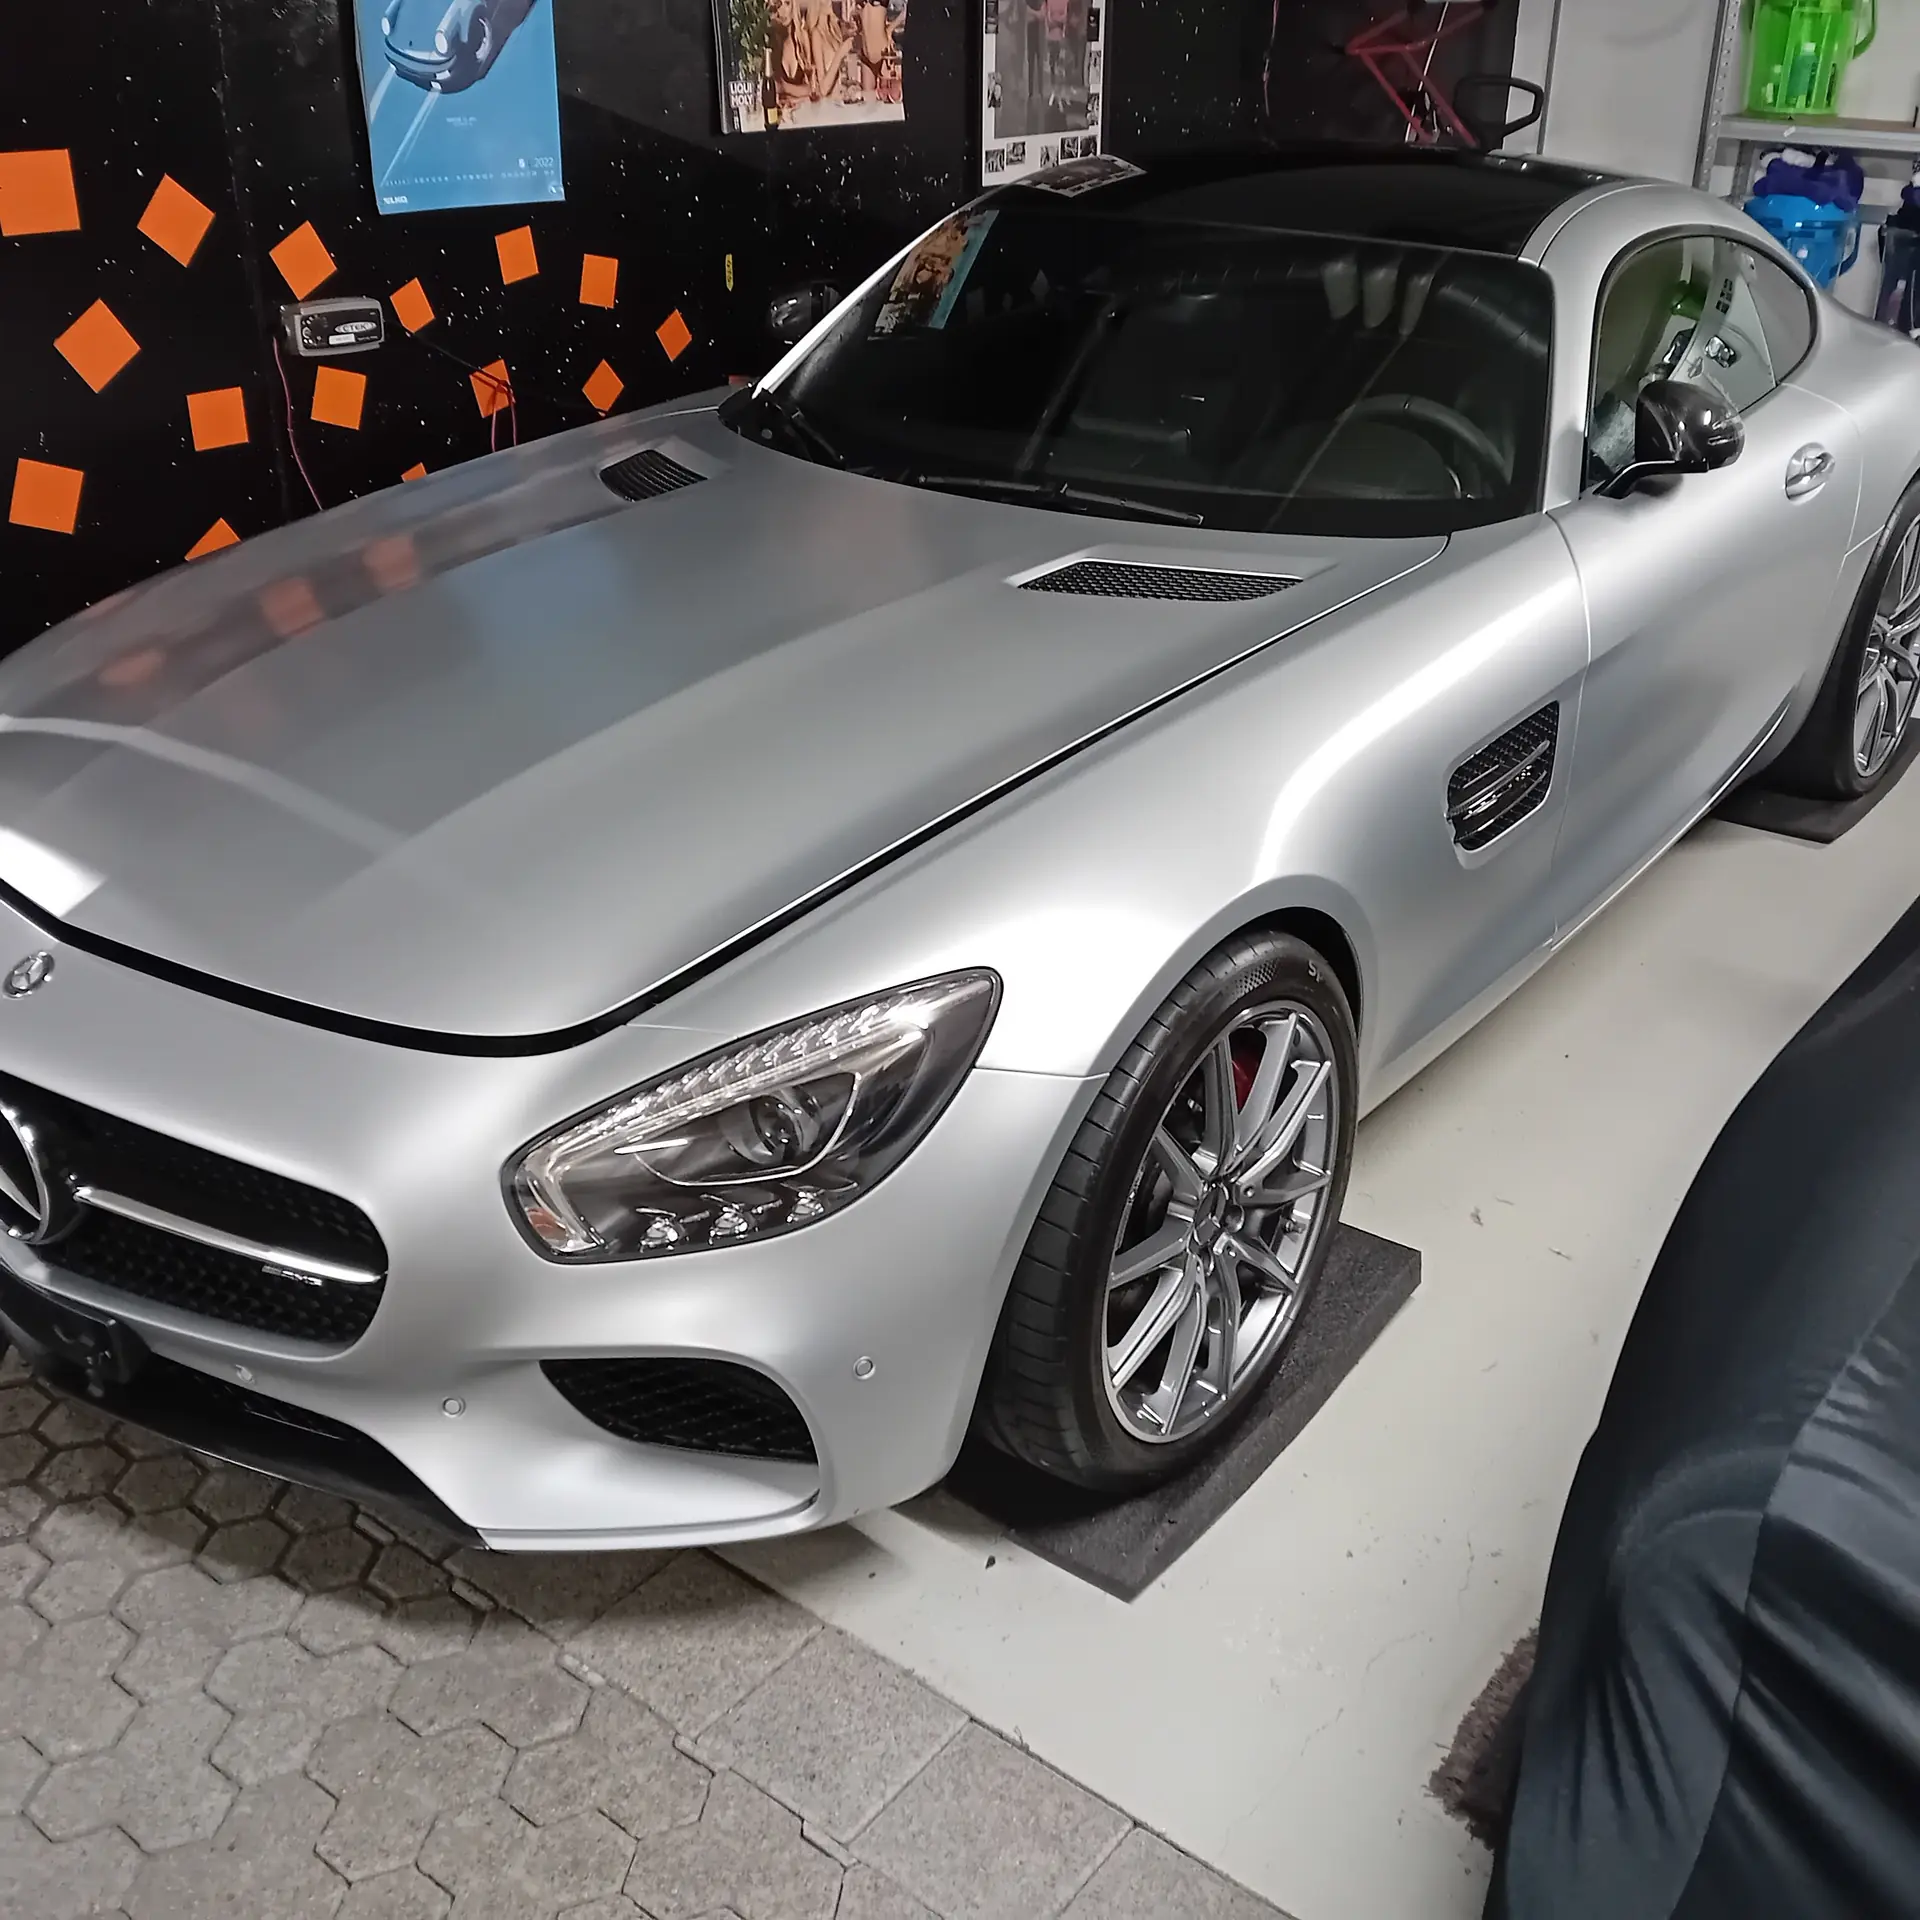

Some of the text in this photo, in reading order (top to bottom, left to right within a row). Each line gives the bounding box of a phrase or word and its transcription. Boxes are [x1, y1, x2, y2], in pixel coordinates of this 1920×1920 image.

[730, 82, 752, 94] LIQUI
[731, 94, 752, 107] MOLY
[534, 156, 554, 168] 2022
